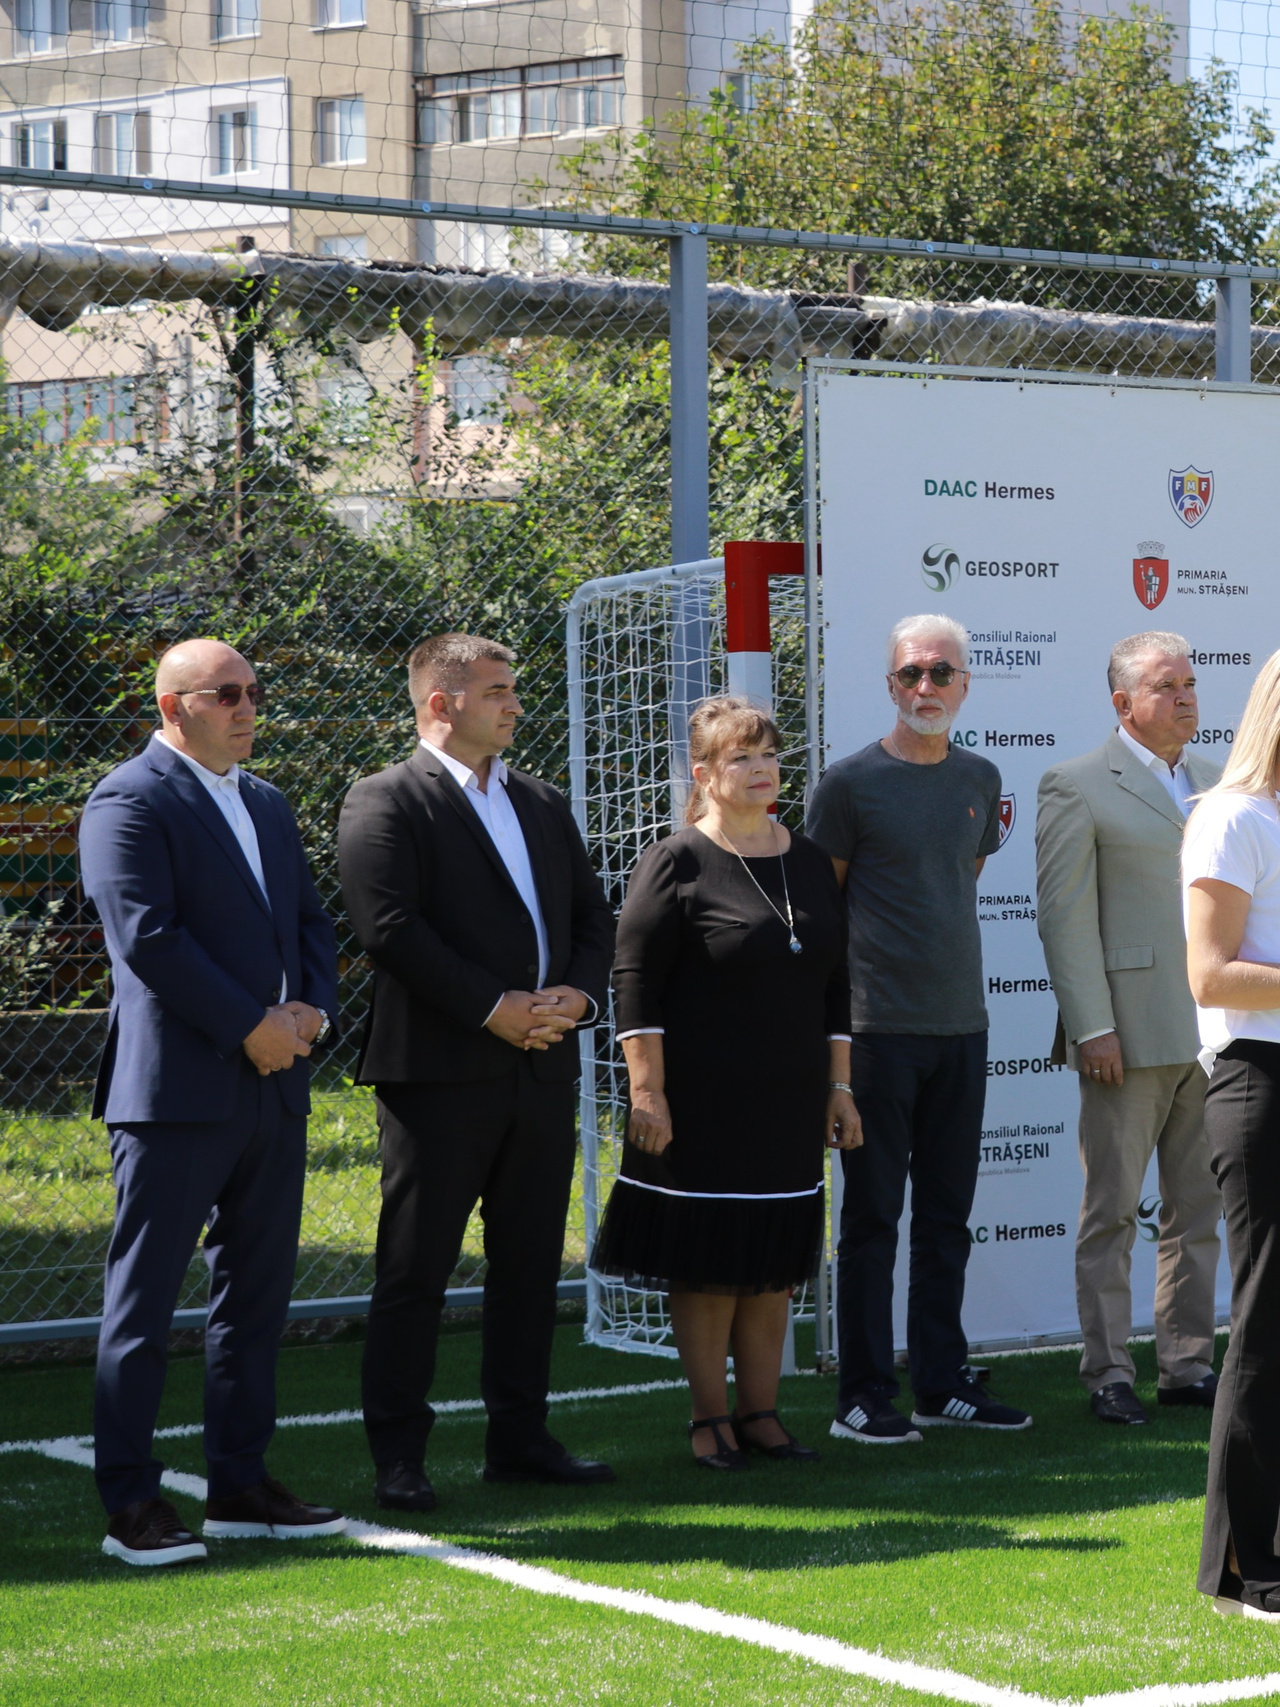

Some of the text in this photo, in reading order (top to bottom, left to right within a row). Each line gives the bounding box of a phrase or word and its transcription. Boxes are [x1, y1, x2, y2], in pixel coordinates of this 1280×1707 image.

[924, 479, 1055, 501] DAAC Hermes
[965, 561, 1060, 579] GEOSPORT
[1177, 570, 1228, 580] PRIMARIA
[1177, 583, 1249, 597] MUN. STRĂȘENI
[1015, 631, 1057, 643] Raional
[953, 730, 1056, 747] AC Hermes
[1188, 729, 1234, 744] OSPO
[979, 895, 1032, 906] PRIMARIA
[1001, 907, 1037, 922] STRĂȘ
[986, 1058, 1062, 1076] EOSPOR
[980, 1121, 1064, 1140] onsiliul Raional
[979, 1142, 1050, 1165] TRĂȘENI
[995, 1222, 1066, 1242] Hermes
